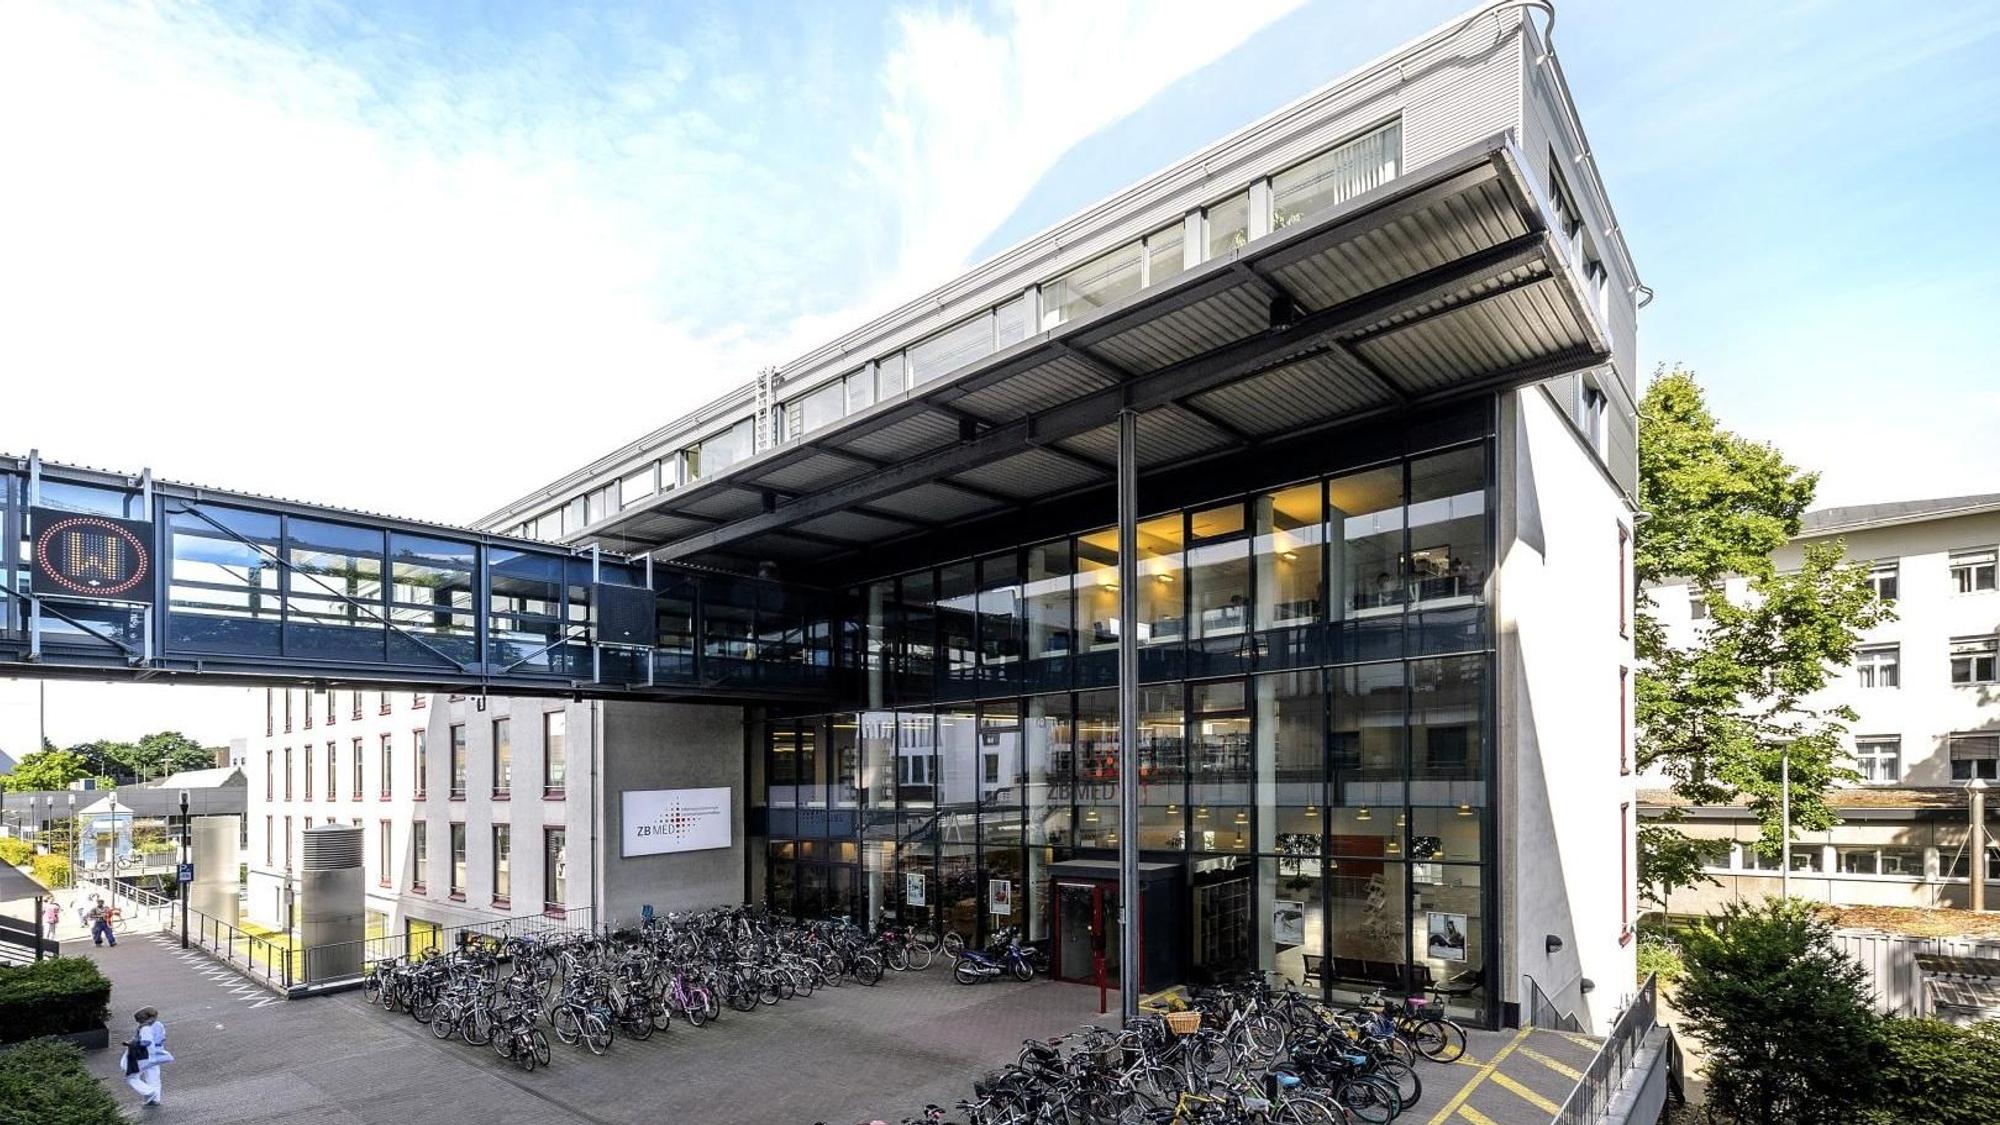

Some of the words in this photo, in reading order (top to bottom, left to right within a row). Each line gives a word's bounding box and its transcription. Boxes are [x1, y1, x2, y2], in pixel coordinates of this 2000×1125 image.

[71, 532, 116, 580] W
[1047, 783, 1070, 800] ZB
[1075, 784, 1115, 800] MED
[637, 826, 651, 836] ZB
[652, 824, 675, 835] MED
